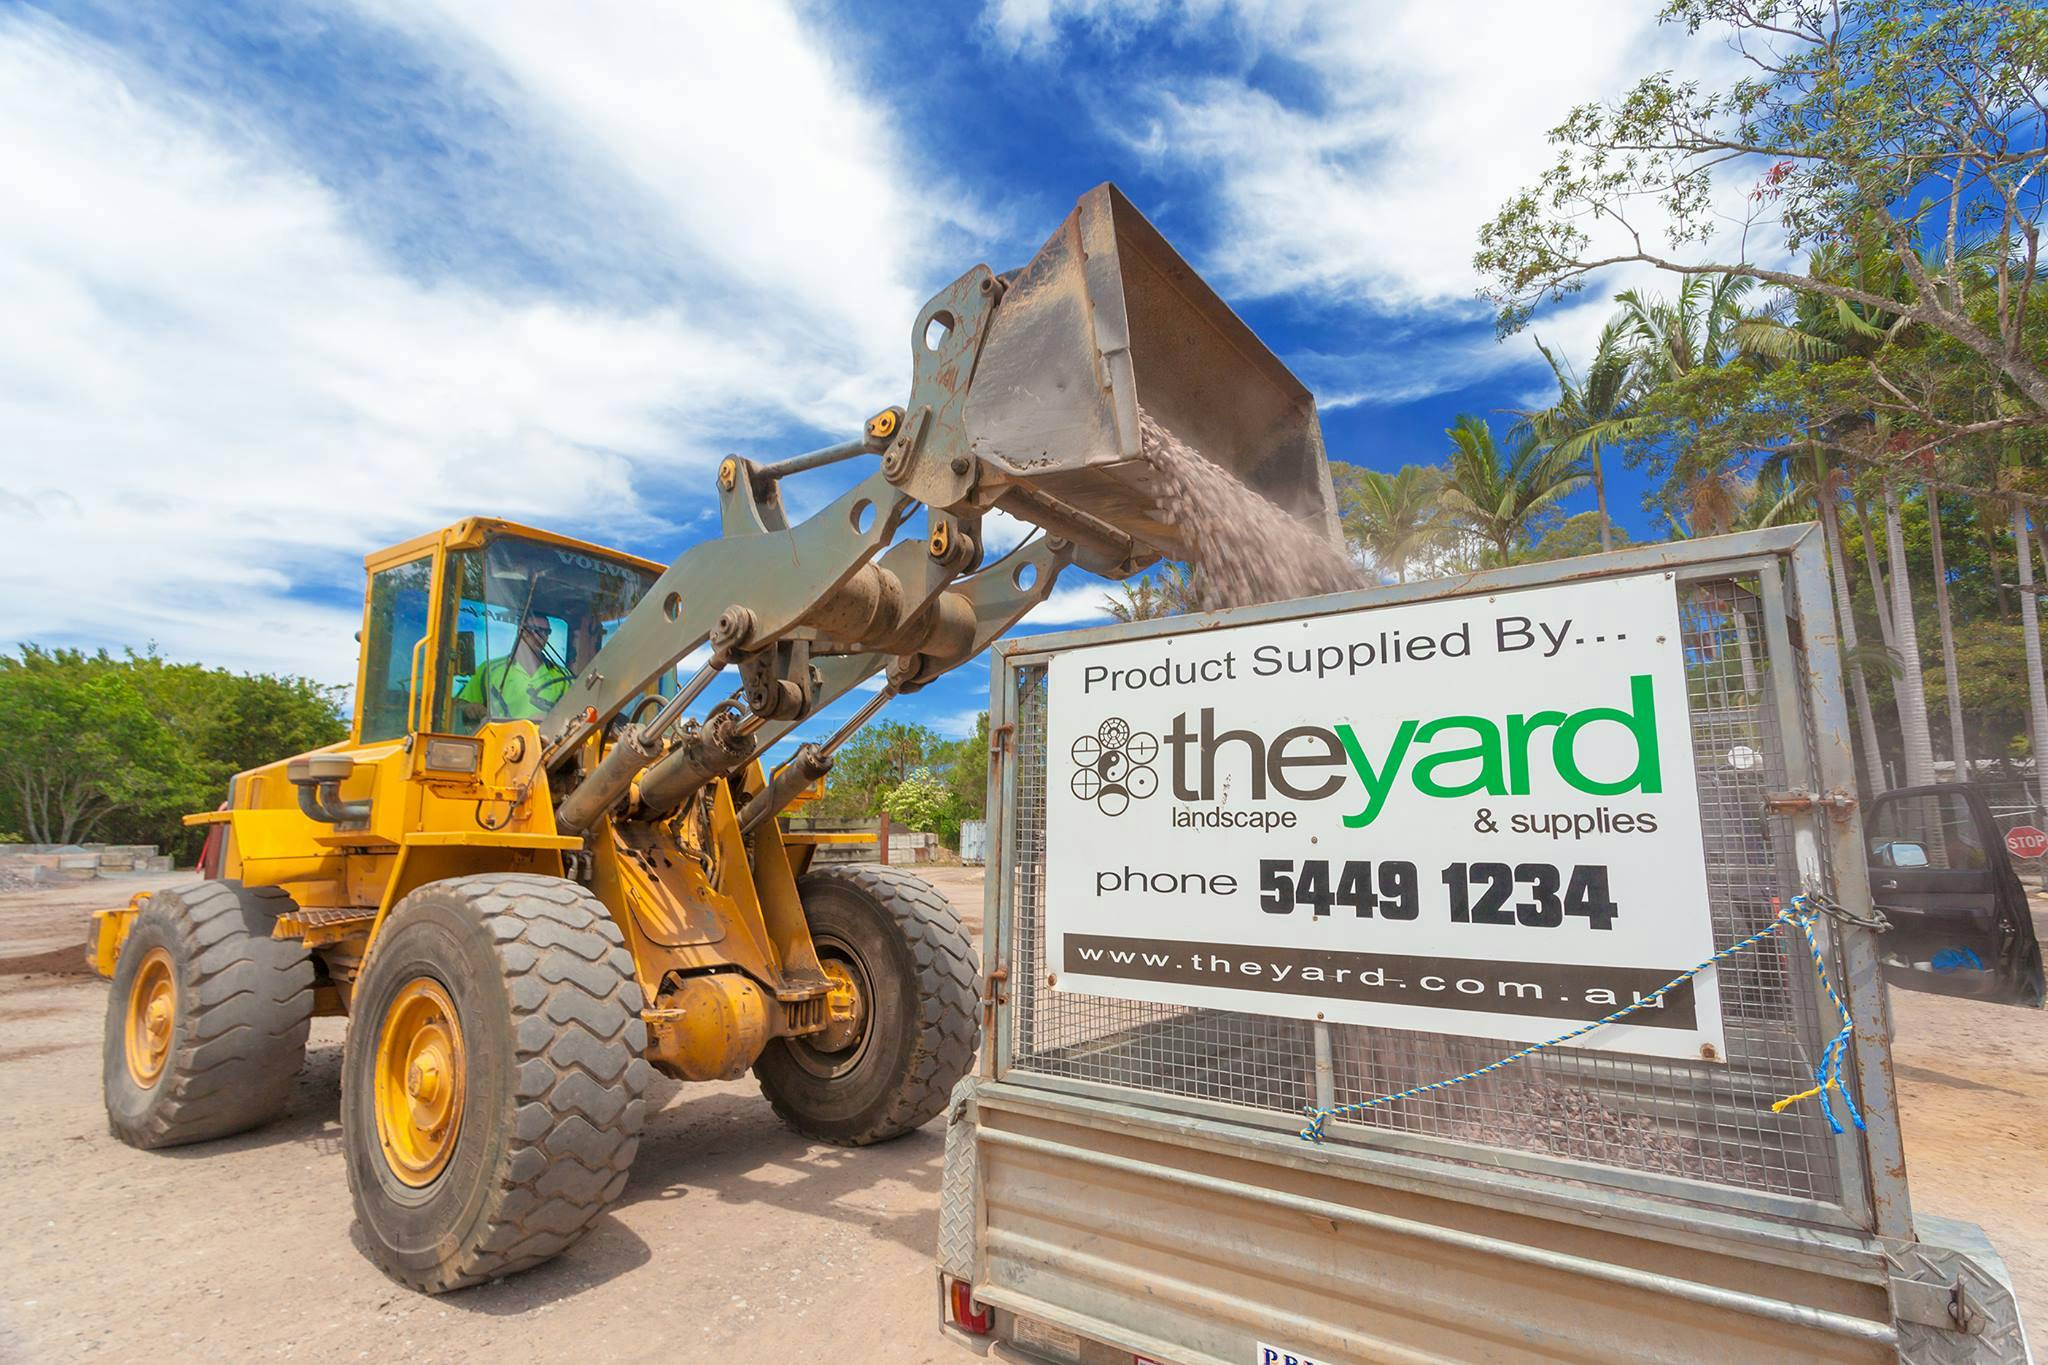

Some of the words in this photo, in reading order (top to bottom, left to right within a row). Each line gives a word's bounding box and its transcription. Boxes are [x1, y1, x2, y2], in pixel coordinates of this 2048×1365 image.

[1084, 651, 1237, 694] Product
[1252, 622, 1471, 679] Supplied
[1172, 806, 1297, 834] landscape
[1473, 807, 1500, 834] &
[1510, 806, 1658, 840] supplies
[2008, 835, 2045, 849] STOP
[1096, 865, 1238, 897] phone
[1259, 858, 1420, 921] 5449
[1441, 862, 1619, 931] 1234
[1078, 947, 1665, 1010] www.theyard.com.au
